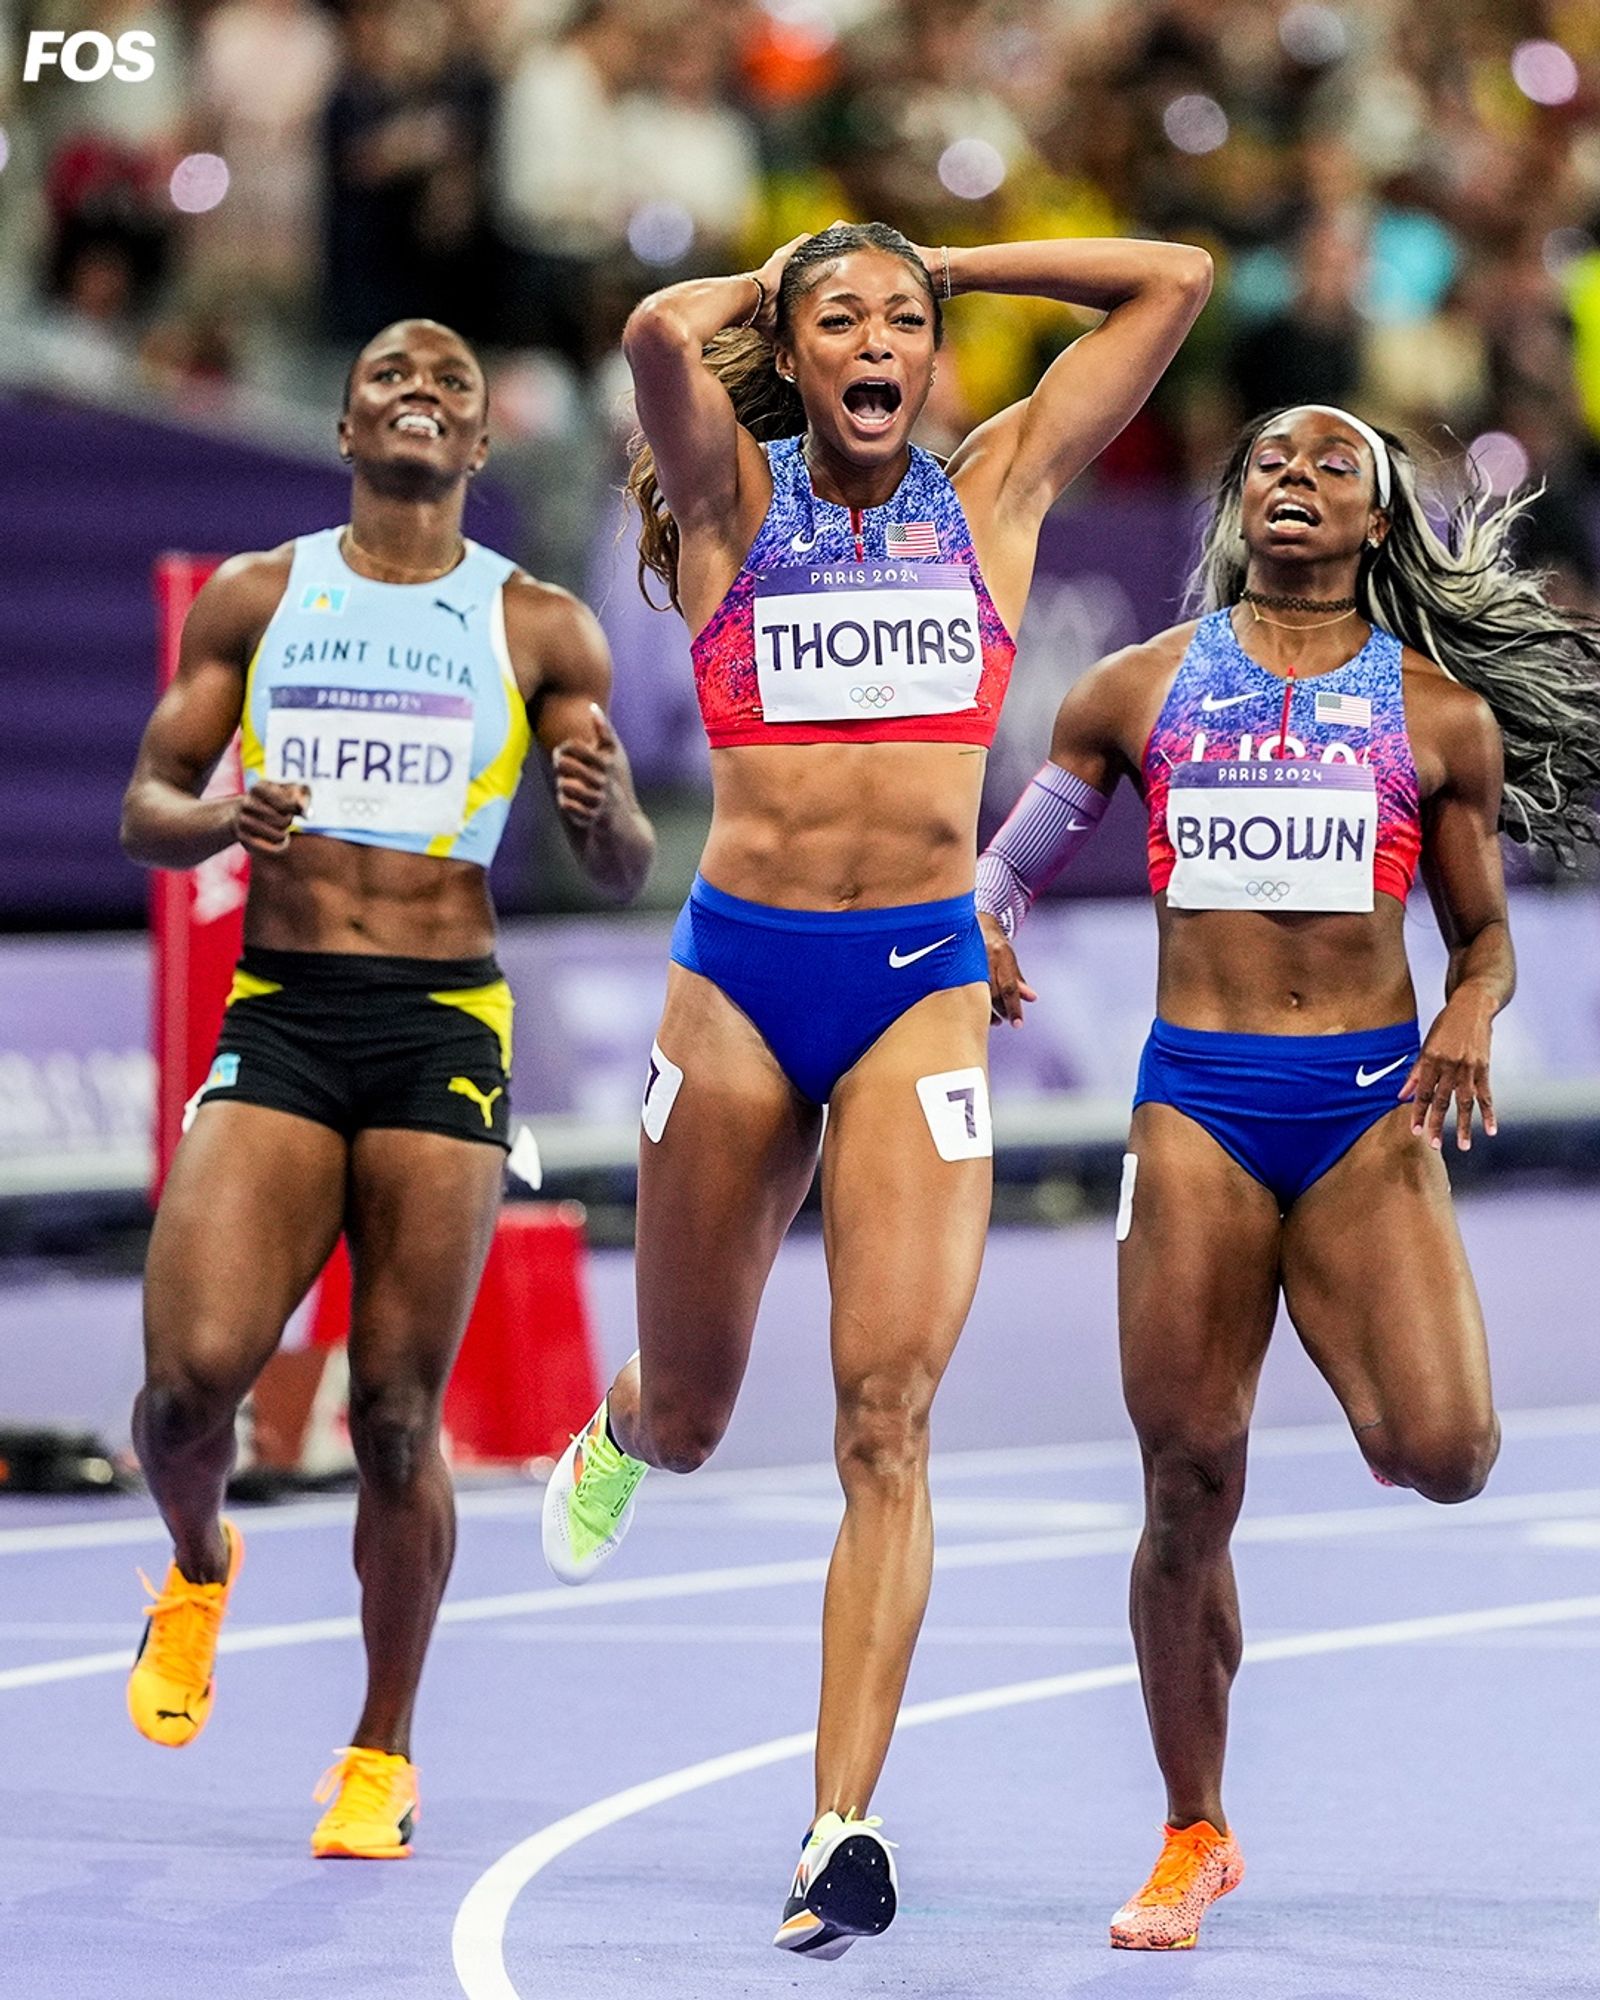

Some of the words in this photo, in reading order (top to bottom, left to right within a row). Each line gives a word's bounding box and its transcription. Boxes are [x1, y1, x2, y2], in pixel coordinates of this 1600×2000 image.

[810, 570, 865, 585] PARIS
[873, 568, 918, 584] 2024
[282, 639, 368, 669] SAINT
[389, 645, 476, 688] LUCIA
[762, 618, 975, 671] THOMAS
[317, 689, 369, 709] PARIS
[373, 691, 422, 711] 2024
[281, 737, 453, 784] ALFRED
[1218, 767, 1268, 782] PARIS
[1274, 767, 1322, 782] 2024
[1177, 816, 1365, 861] BROWN
[946, 1087, 977, 1138] 7
